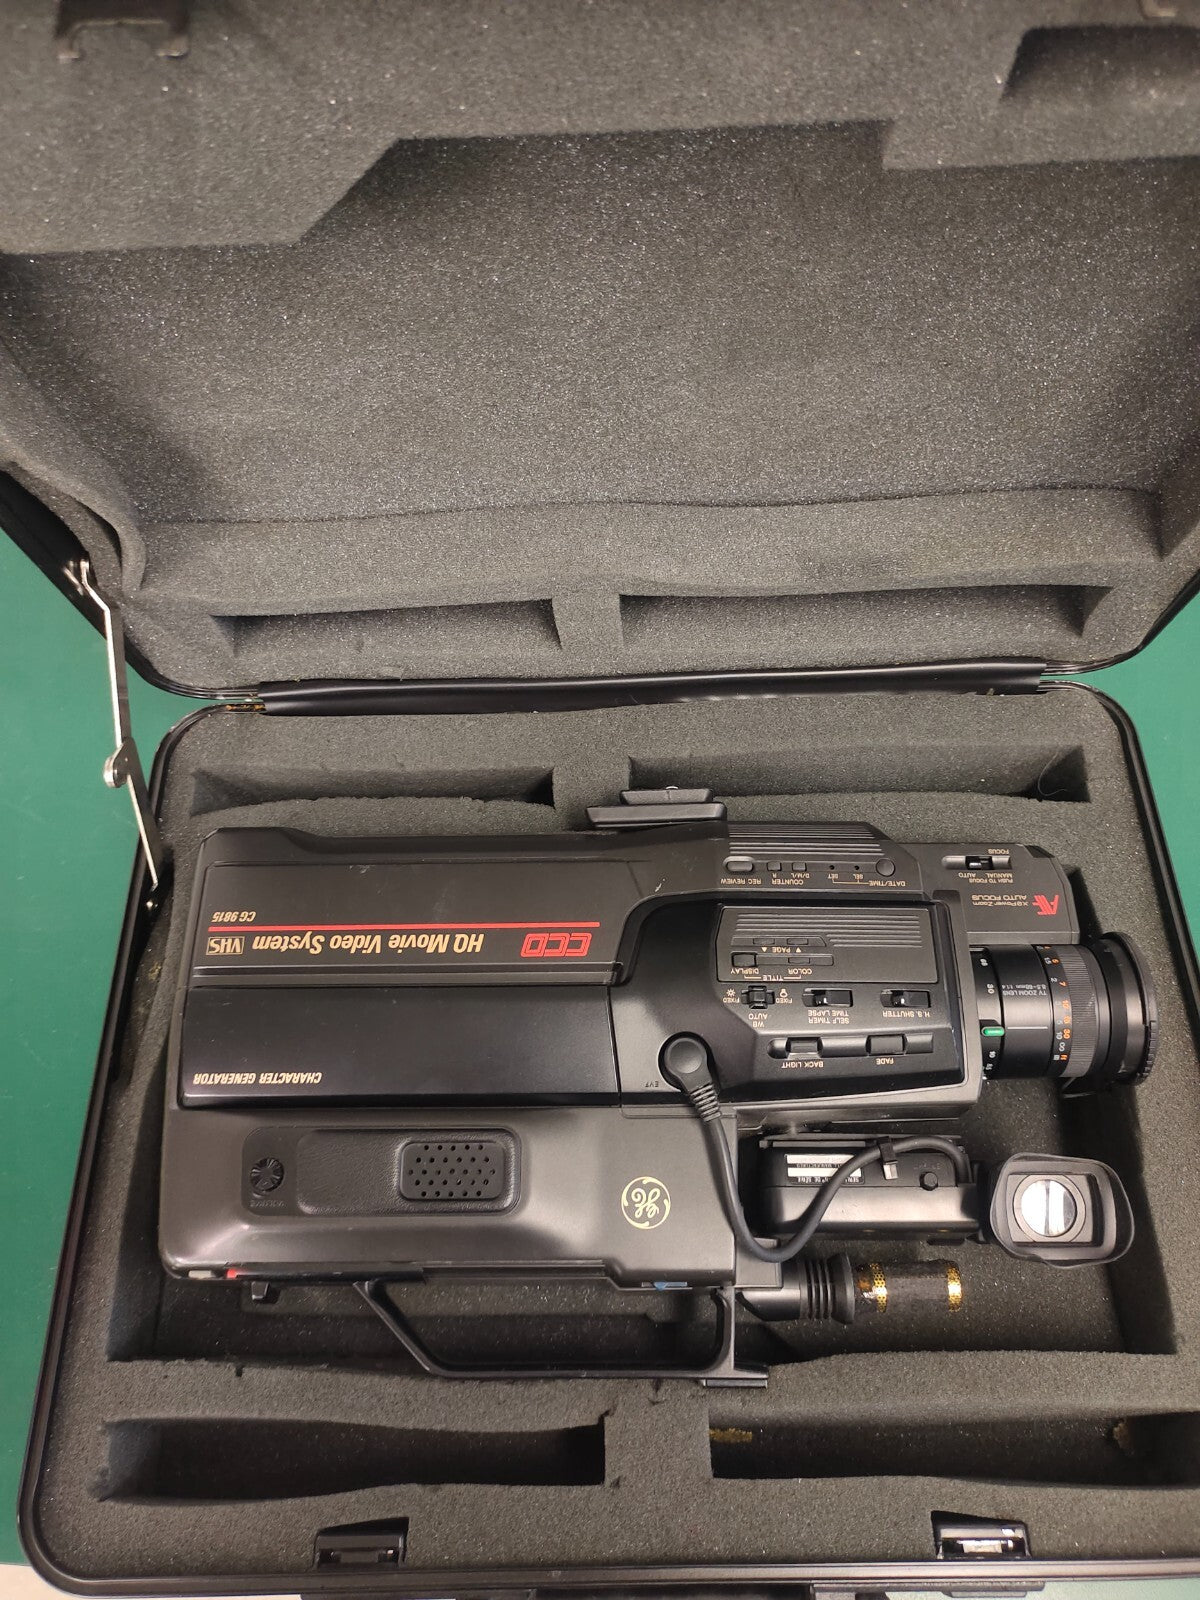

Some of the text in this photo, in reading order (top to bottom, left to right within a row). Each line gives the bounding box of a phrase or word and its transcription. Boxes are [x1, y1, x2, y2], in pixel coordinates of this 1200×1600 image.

[212, 911, 256, 922] CG 9815
[207, 937, 243, 954] VHS
[252, 930, 484, 955] HQ Movie Video System
[520, 932, 592, 957] CCD
[987, 983, 995, 994] 30
[1056, 1031, 1063, 1040] 10
[781, 1061, 802, 1069] LIGHT
[193, 1072, 322, 1085] CHARACTER GENERATOR
